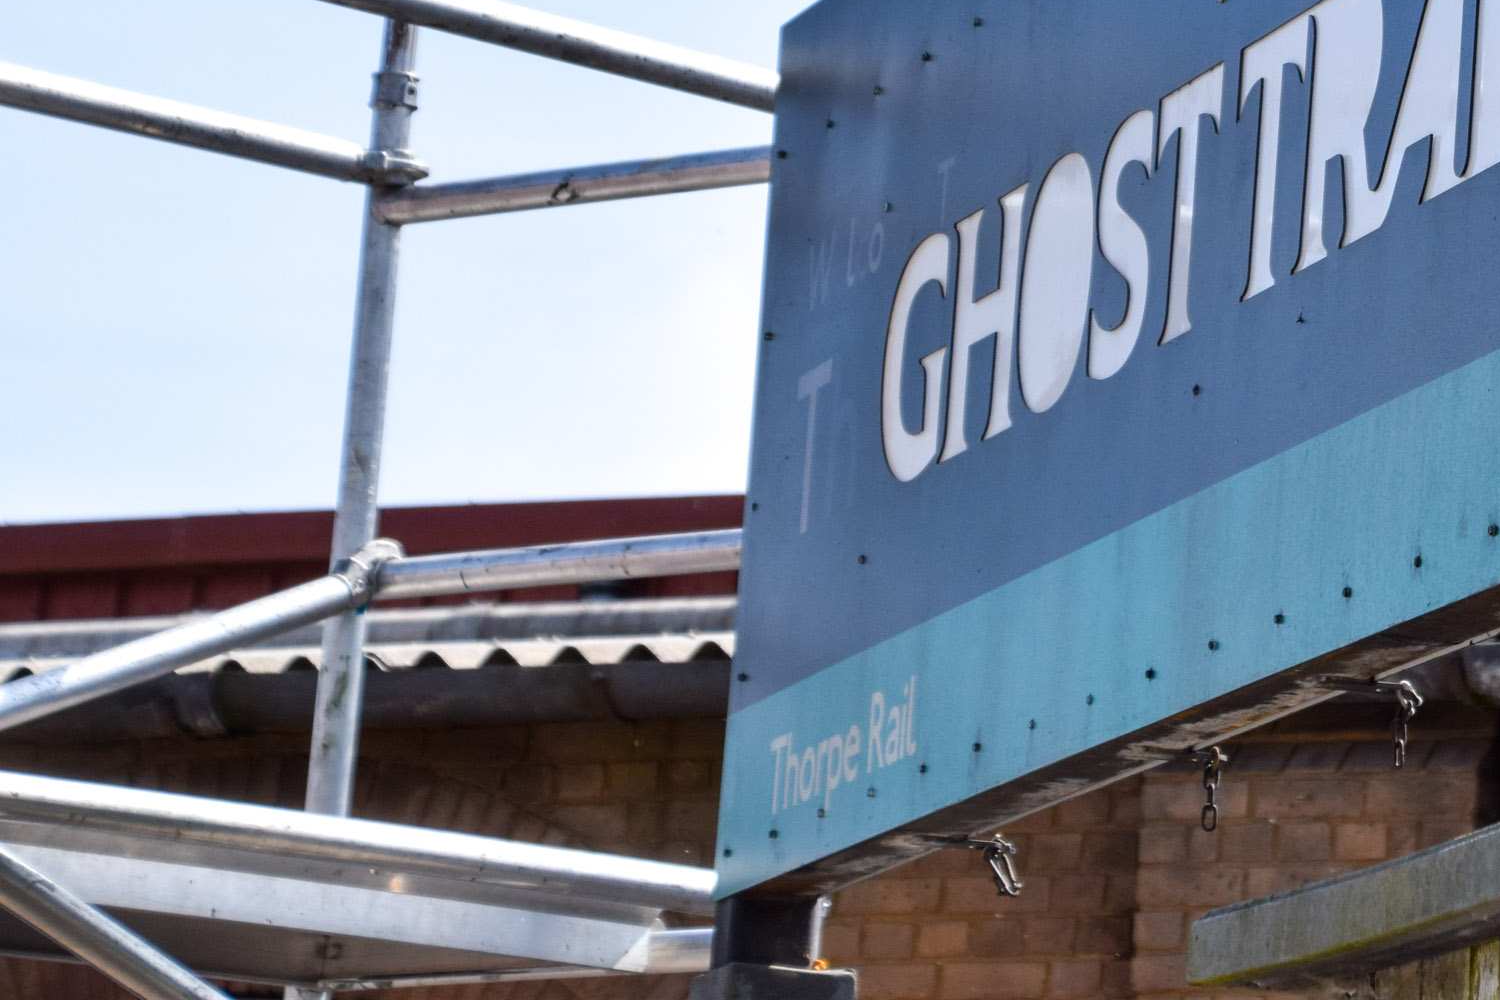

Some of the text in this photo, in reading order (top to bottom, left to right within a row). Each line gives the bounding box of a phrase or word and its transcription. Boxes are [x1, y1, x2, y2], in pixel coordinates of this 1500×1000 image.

[881, 60, 1224, 482] GHOST
[771, 675, 917, 816] Thorpe Rail
